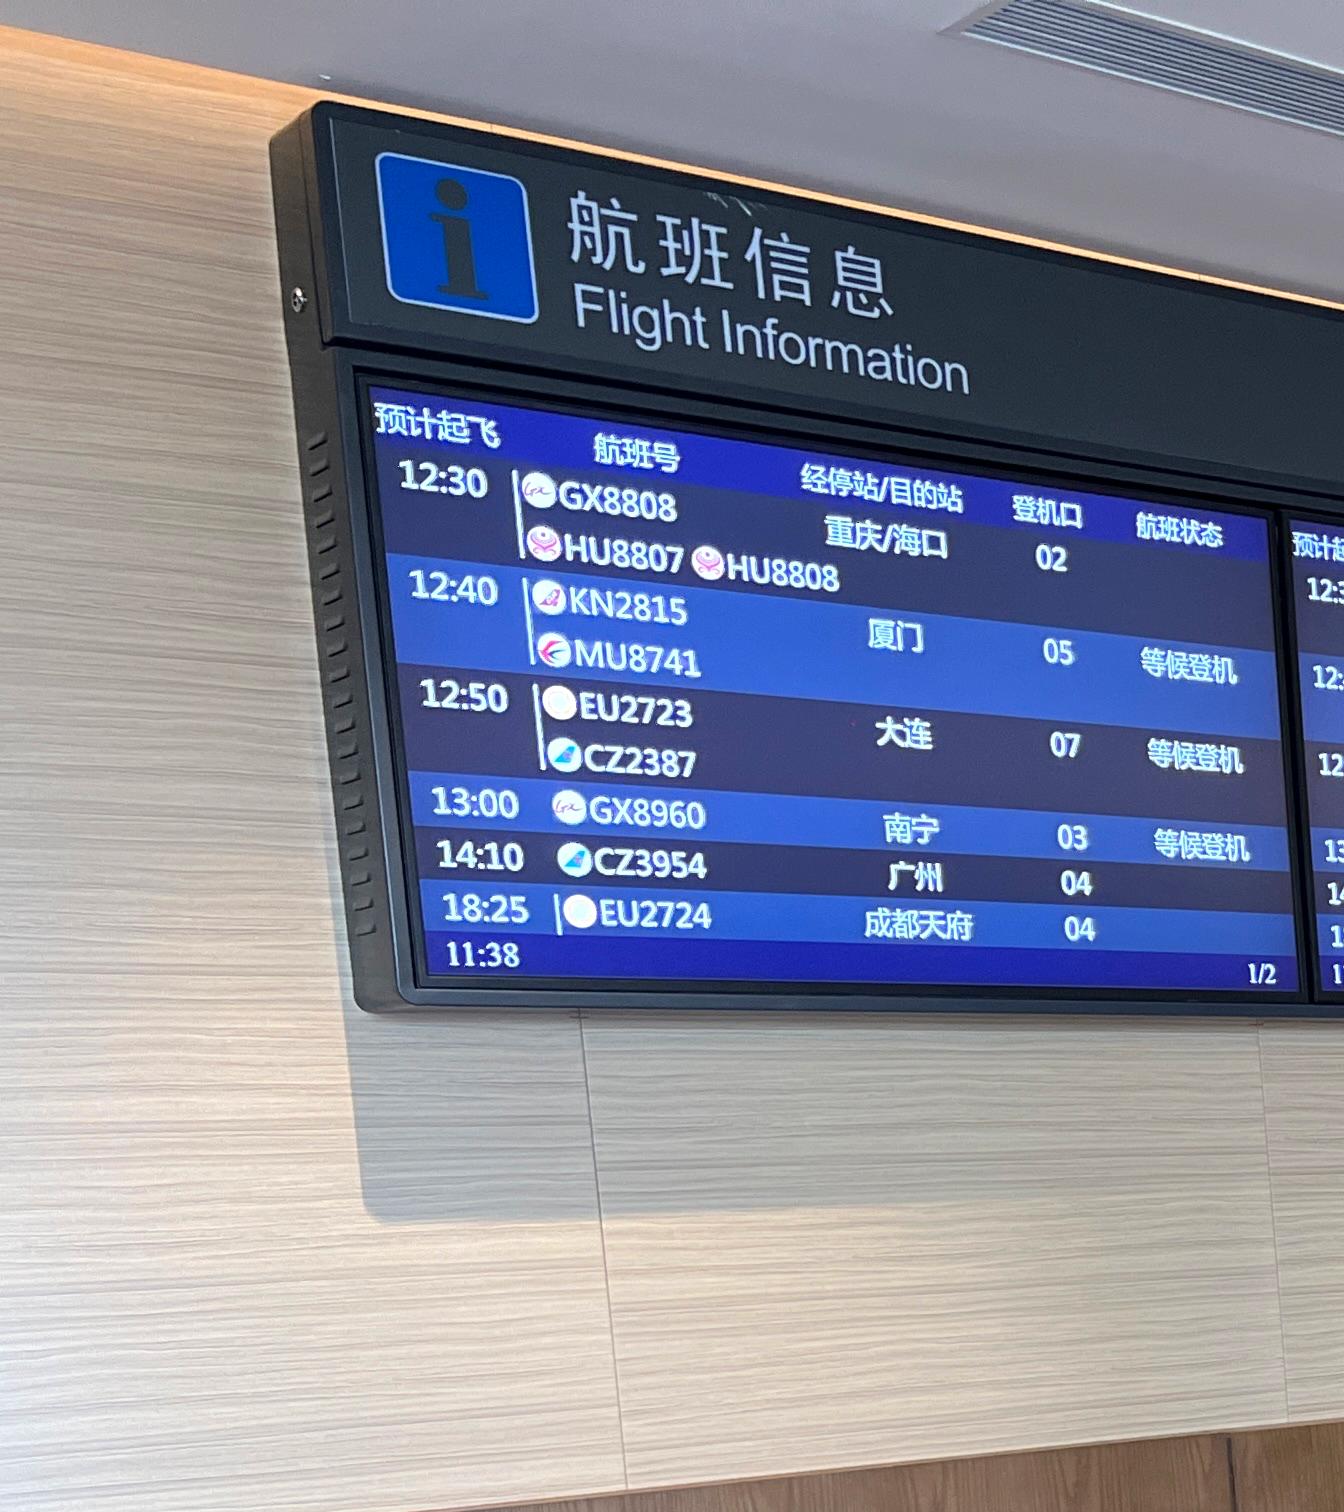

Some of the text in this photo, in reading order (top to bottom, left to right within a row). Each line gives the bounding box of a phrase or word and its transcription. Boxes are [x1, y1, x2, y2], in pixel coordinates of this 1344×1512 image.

[568, 189, 894, 319] 航班信息
[575, 280, 969, 394] Flight Information
[374, 403, 1223, 547] 预计起飞 航班号 经停站/目的站 登机口 航班状态
[398, 460, 487, 497] 12:30
[559, 481, 677, 521] GX8808
[824, 516, 947, 559] 重庆/海口
[1036, 544, 1067, 571] 02
[564, 534, 839, 591] HU8807 HU8808
[410, 570, 1238, 684] 12:40 KN2815 厦门 05 等候登机
[575, 640, 701, 677] MU8741
[420, 679, 1243, 774] 12:50 EU2723 大连 07 等候登机
[585, 744, 696, 777] CZ2387
[432, 787, 519, 818] 13:00
[590, 796, 705, 829] GX8960
[883, 812, 939, 844] 南宁
[1058, 825, 1088, 850] 03
[1154, 828, 1250, 861] 等候登机
[437, 840, 1092, 895] 14:10 CZ3954 广州 04
[443, 894, 1095, 941] 18:25 EU2724 成都天府 04
[447, 942, 1276, 984] 11:38 1/2
